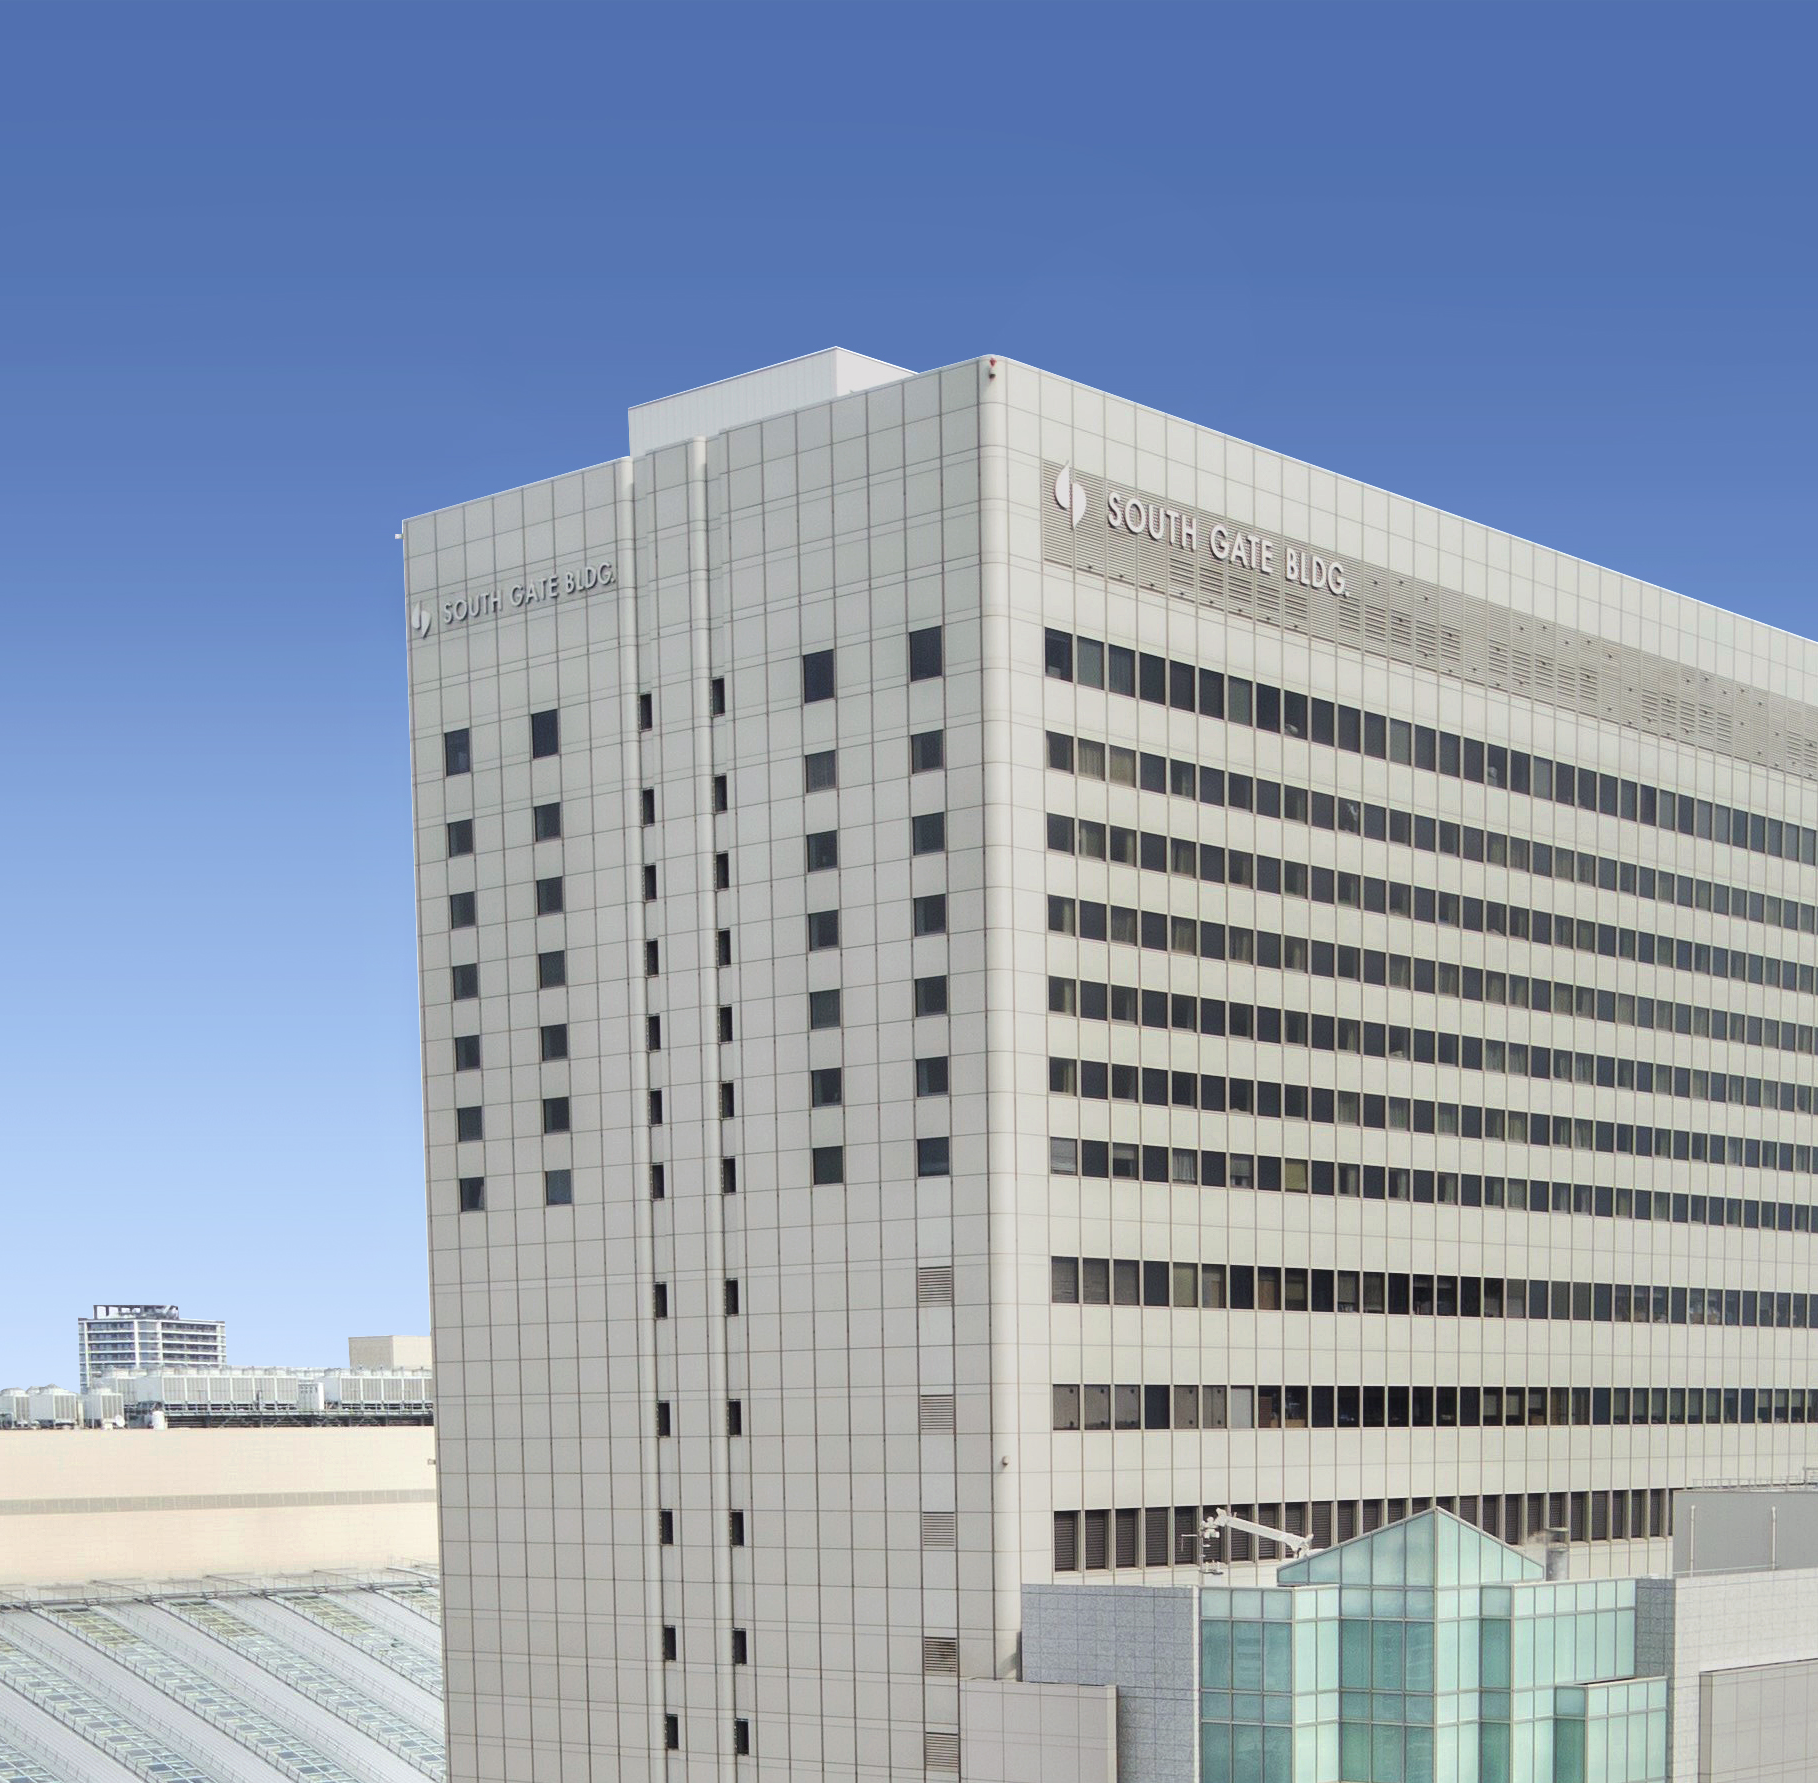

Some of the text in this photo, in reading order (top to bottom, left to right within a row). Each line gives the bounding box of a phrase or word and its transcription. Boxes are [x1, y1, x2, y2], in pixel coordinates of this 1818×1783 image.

[1107, 492, 1351, 597] SOUTH GATE BLDG.
[444, 562, 615, 624] SOUTH GATE BLDG.
